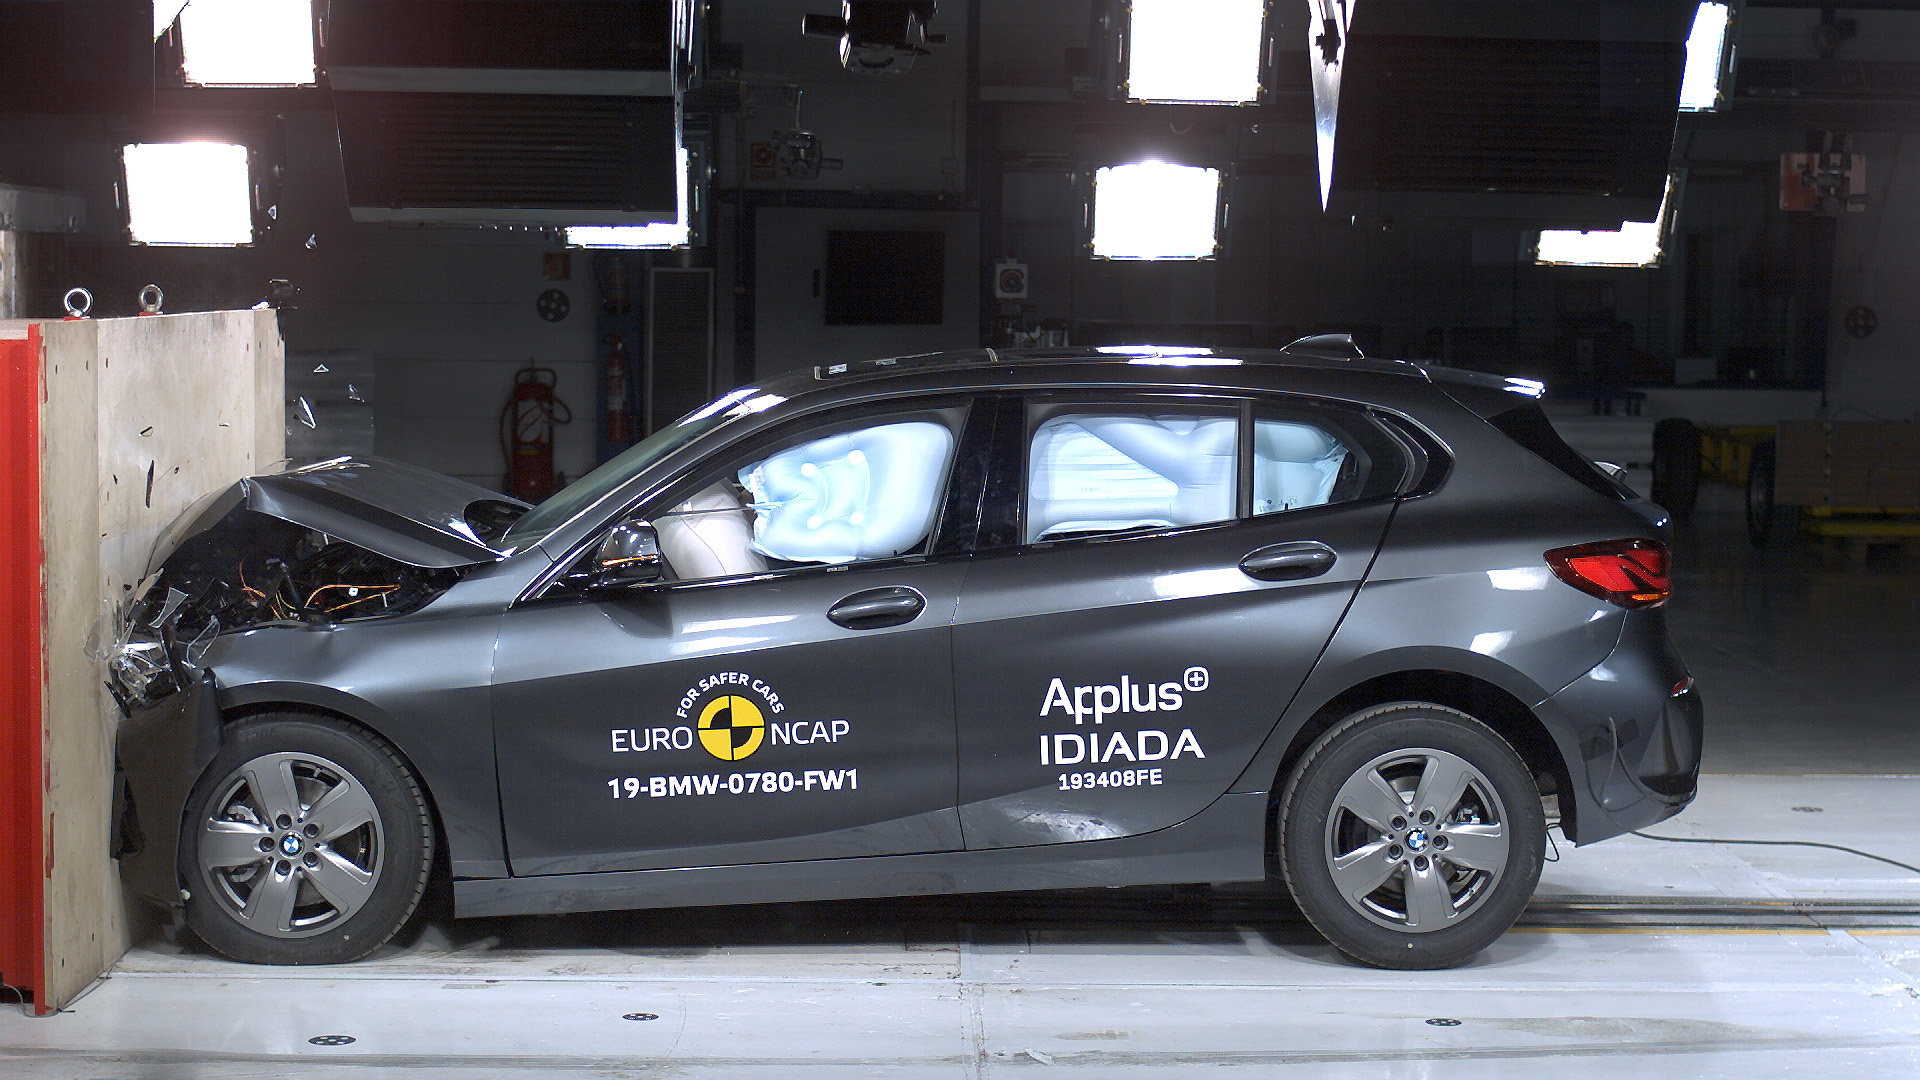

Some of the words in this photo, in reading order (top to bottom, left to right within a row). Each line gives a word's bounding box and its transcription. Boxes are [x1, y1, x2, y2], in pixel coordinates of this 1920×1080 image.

[676, 687, 701, 719] FOR
[698, 672, 750, 692] SAFER
[751, 679, 785, 714] CARS
[611, 726, 693, 753] EURO
[770, 719, 850, 746] NCAP
[1040, 728, 1206, 766] IDIADA
[607, 769, 858, 799] 19-BMW-0780-FW1
[1058, 768, 1163, 791] 193408FE
